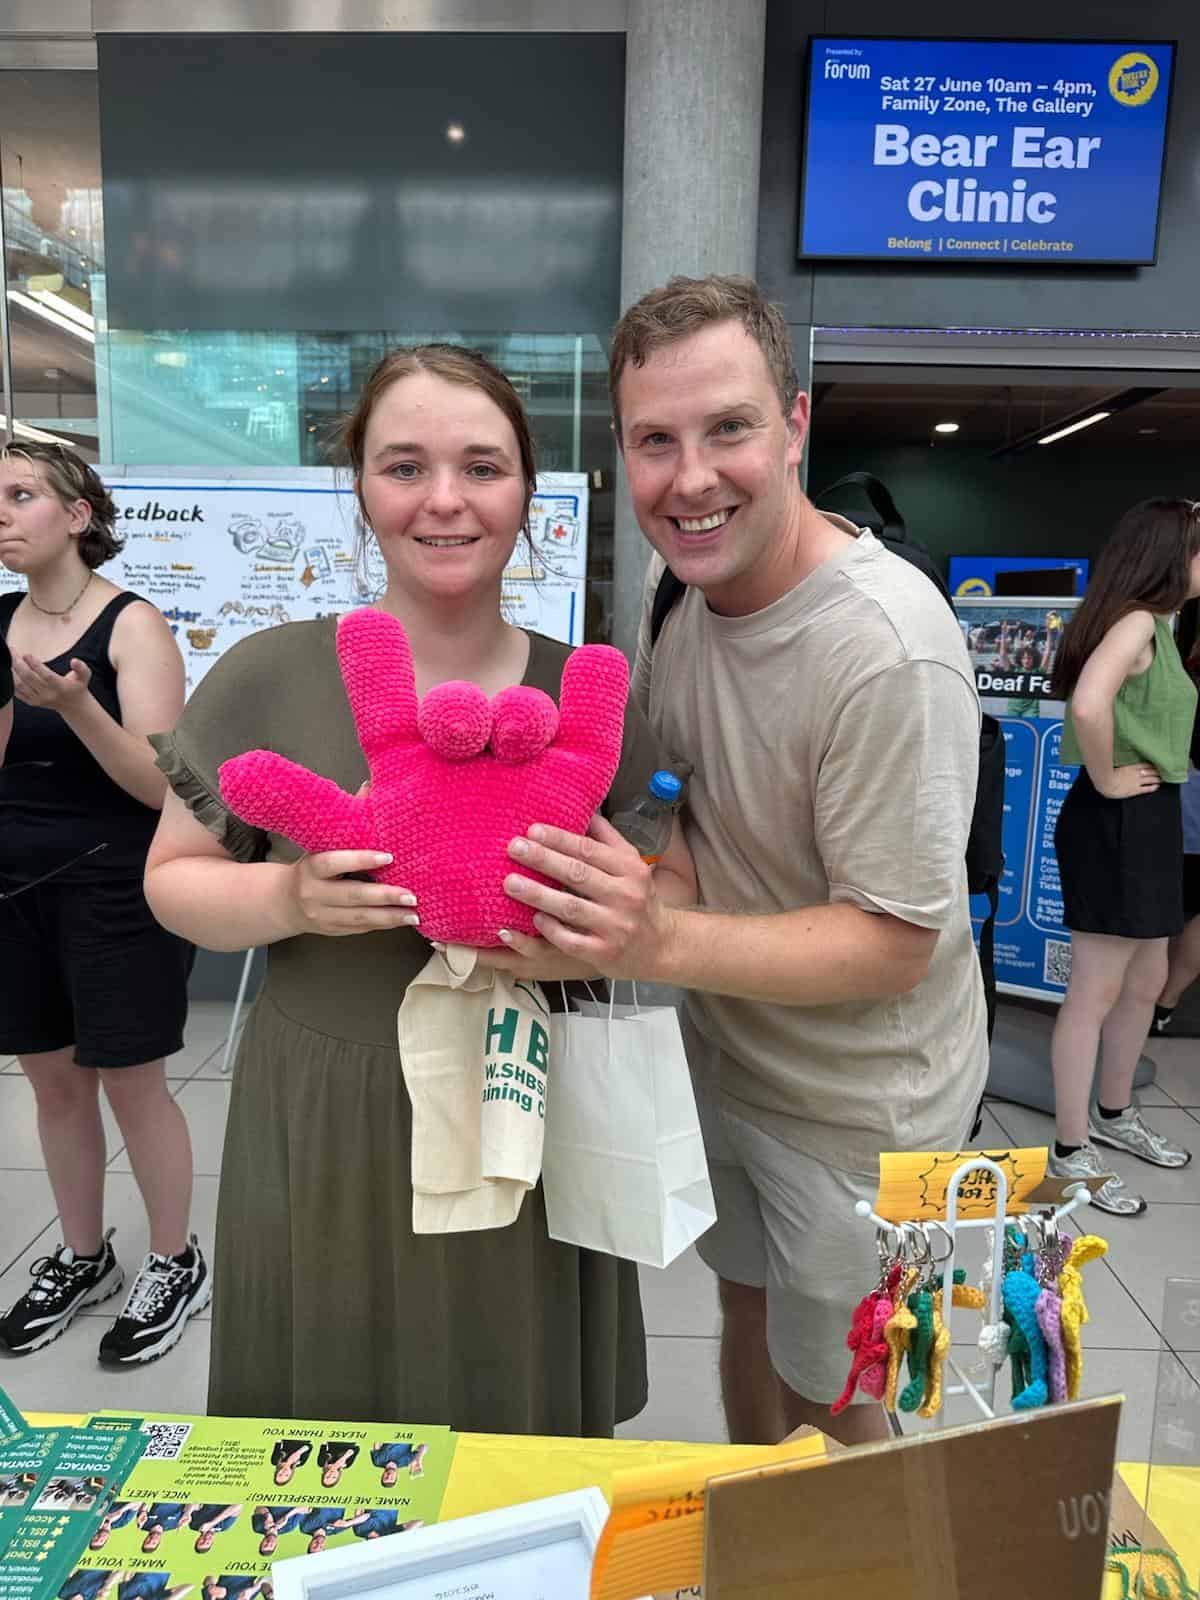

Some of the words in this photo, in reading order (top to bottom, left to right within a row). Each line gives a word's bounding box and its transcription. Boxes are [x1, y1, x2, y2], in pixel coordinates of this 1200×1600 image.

[824, 59, 870, 79] forum
[880, 76, 909, 92] Sat
[913, 77, 935, 92] 27
[939, 78, 982, 93] June
[986, 78, 1031, 95] 10am
[1053, 79, 1097, 97] 4pm,
[881, 95, 939, 115] Family
[943, 97, 991, 115] Zone,
[996, 97, 1028, 113] The
[1032, 98, 1093, 118] Gallery
[873, 124, 997, 168] Bear
[1011, 126, 1102, 169] Ear
[907, 177, 1057, 224] Clinic
[887, 237, 932, 252] Belong
[946, 238, 1001, 251] Connect
[1011, 239, 1074, 252] Celebrate
[978, 674, 1024, 692] Deaf
[1049, 769, 1071, 780] The
[262, 1427, 287, 1438] YOU
[290, 1429, 325, 1440] THANK
[328, 1429, 367, 1440] PLEASE
[394, 1431, 414, 1440] BYE
[54, 1461, 111, 1472] CONTACT
[246, 1491, 352, 1505] (FINGERSPELLING)?
[353, 1495, 373, 1505] ME
[224, 1560, 257, 1571] YOU?
